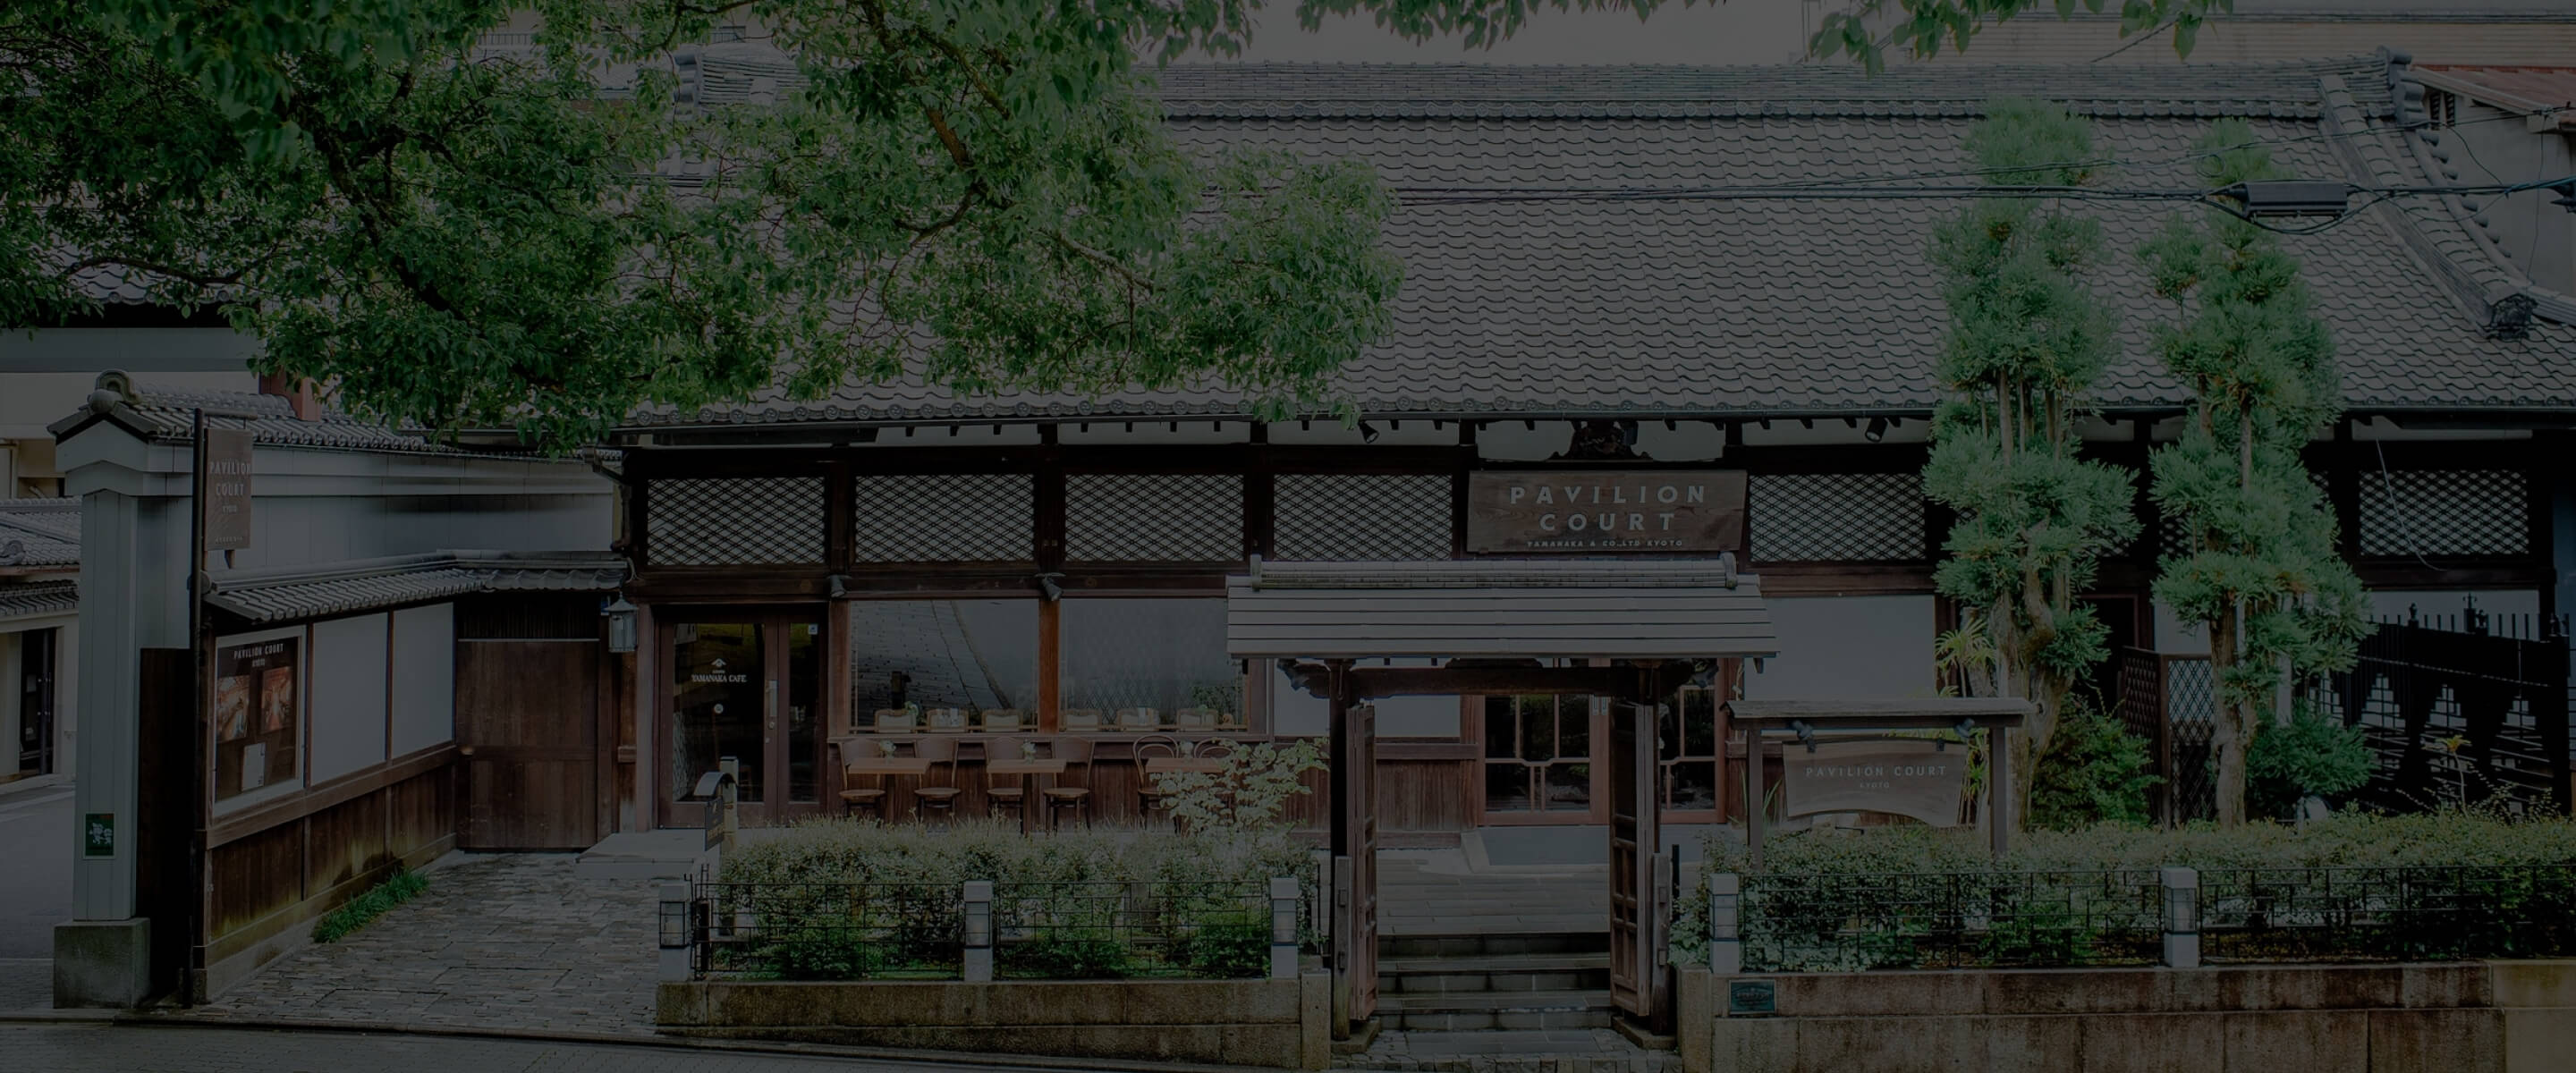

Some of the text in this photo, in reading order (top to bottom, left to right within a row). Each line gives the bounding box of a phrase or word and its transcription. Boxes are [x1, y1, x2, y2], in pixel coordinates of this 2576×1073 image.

[210, 461, 251, 475] PAVILION
[216, 484, 244, 496] COURT
[1510, 486, 1704, 504] PAVILION
[1538, 513, 1675, 531] COURT
[1647, 539, 1682, 547] KYOTO
[233, 643, 284, 660] PAVILION COURT
[1805, 765, 1947, 777] PAVILION COURT
